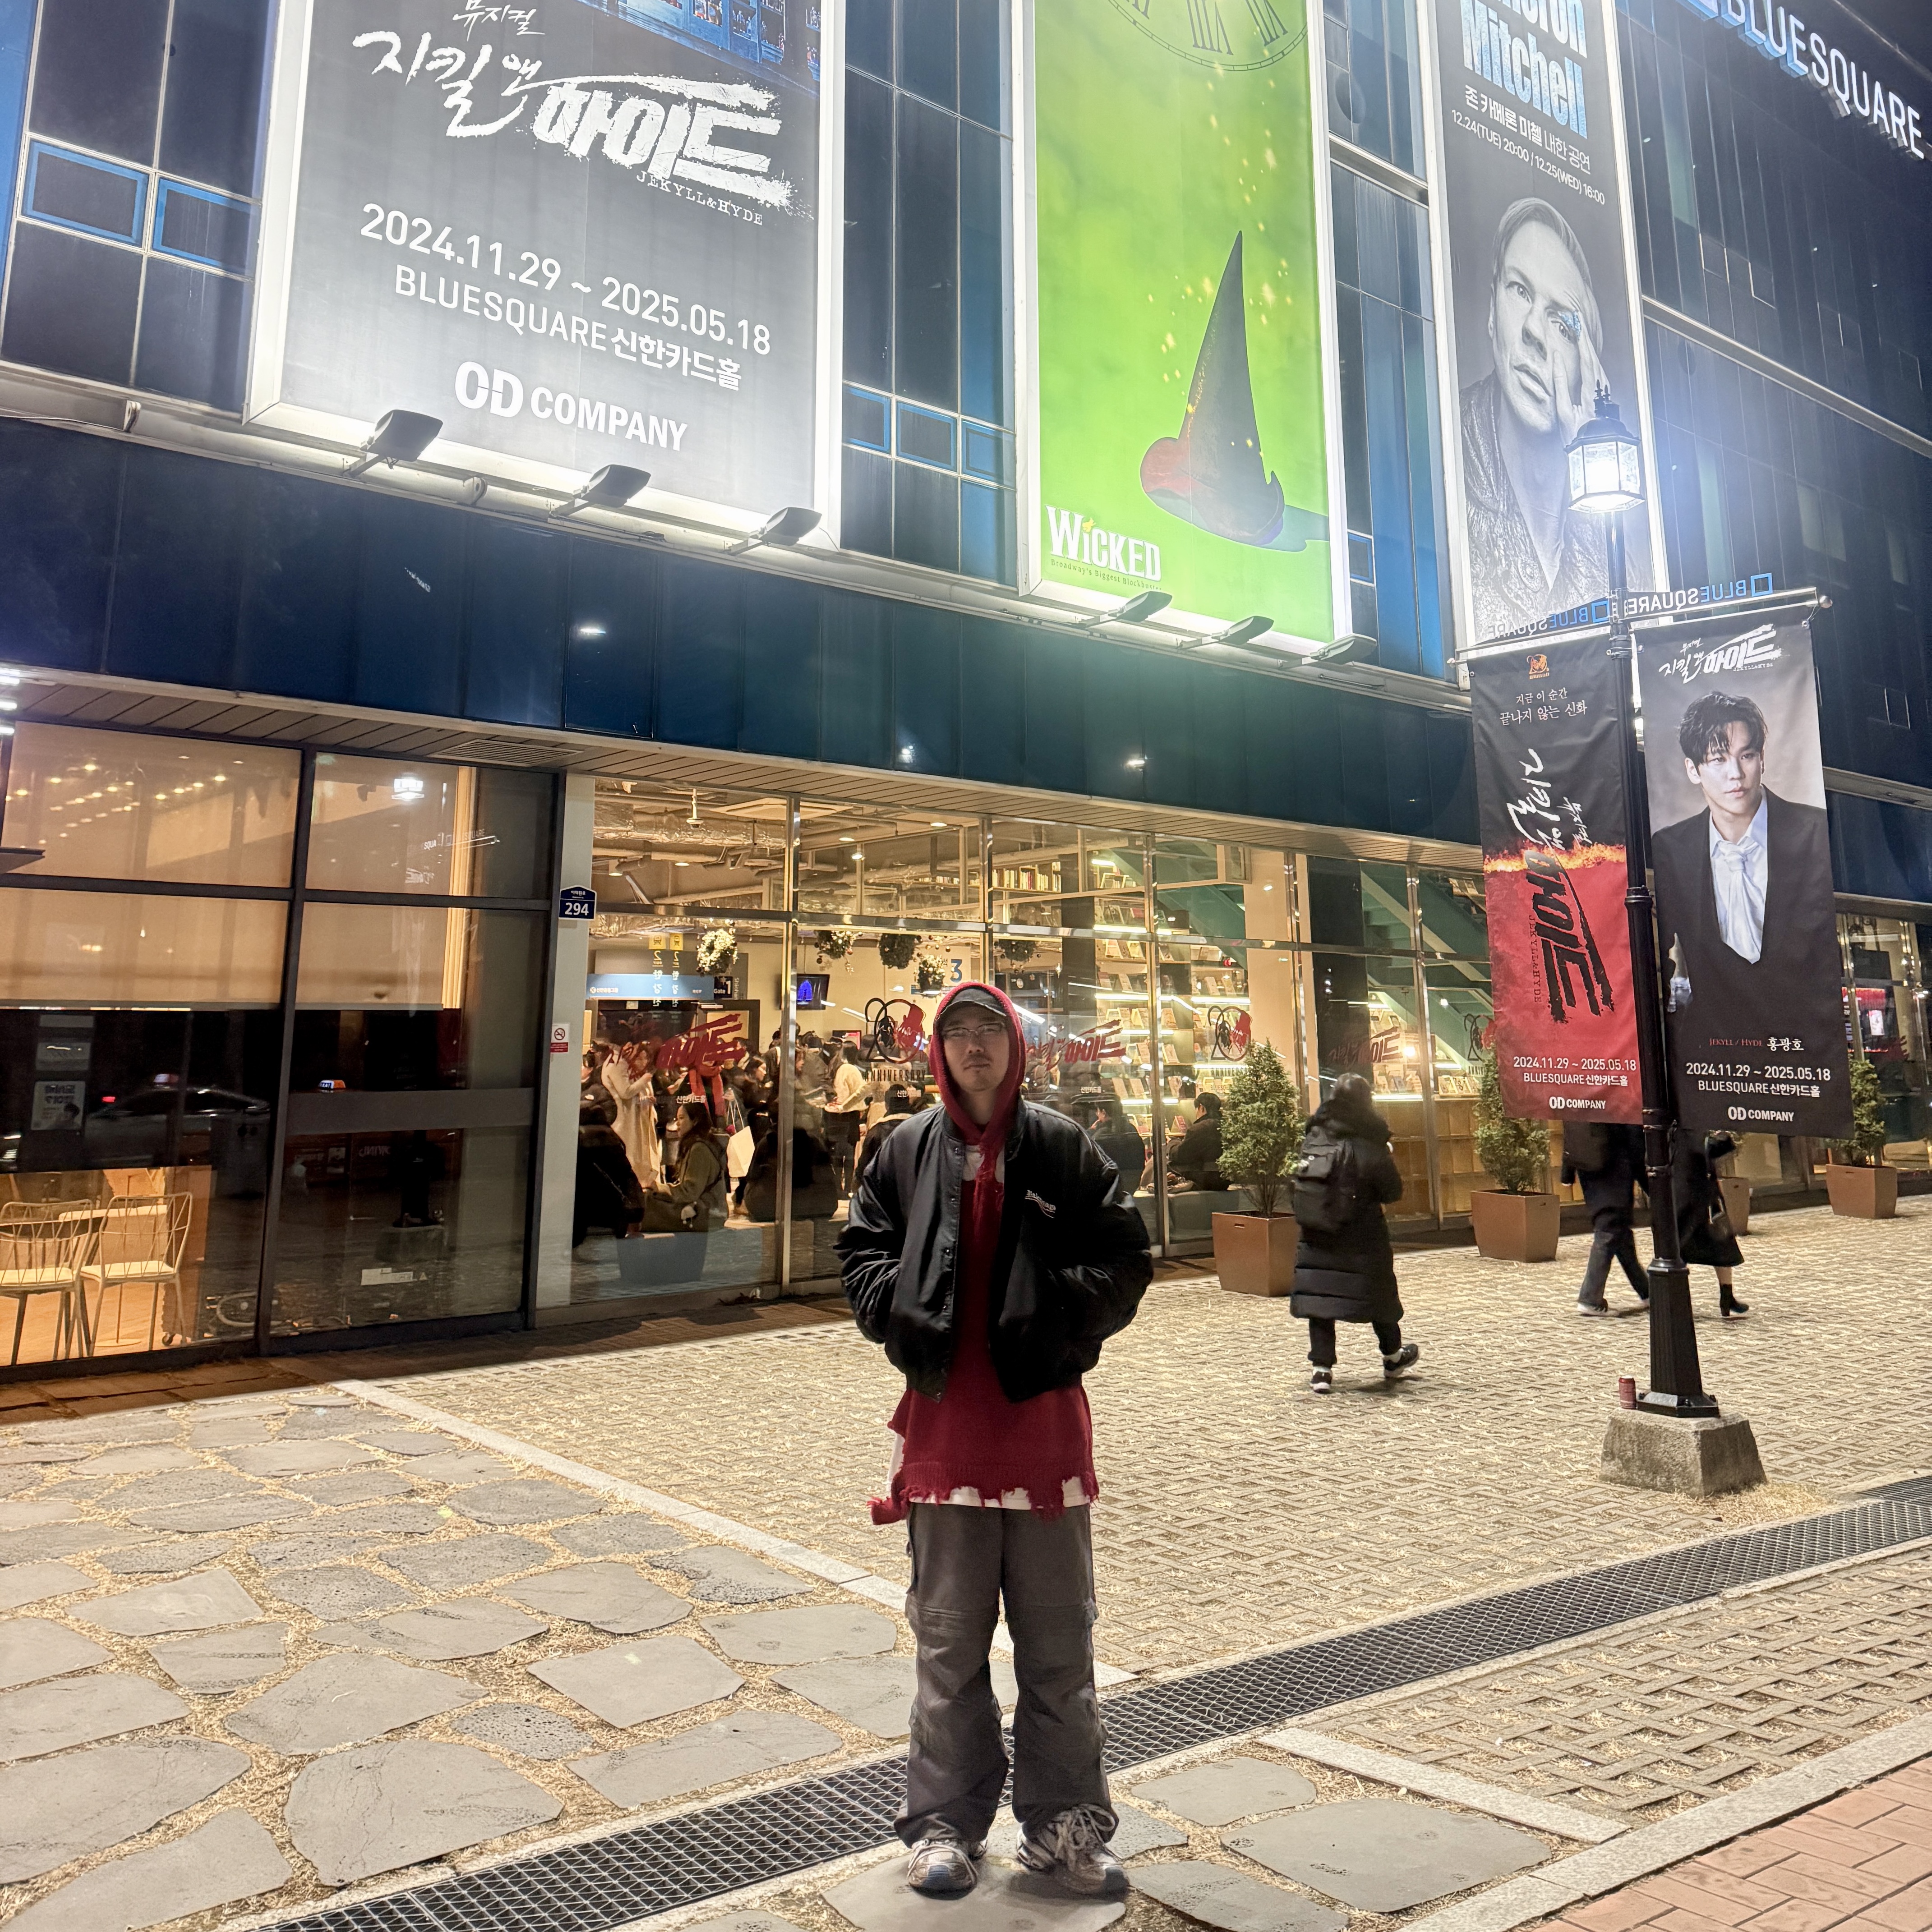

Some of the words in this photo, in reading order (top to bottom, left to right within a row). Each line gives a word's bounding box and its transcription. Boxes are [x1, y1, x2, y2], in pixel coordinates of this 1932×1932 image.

[452, 0, 545, 41] 뮤지컬
[1460, 0, 1587, 139] Mitchell
[1722, 0, 1924, 159] BLUESQUARE
[1465, 84, 1478, 110] 존
[1480, 93, 1517, 132] 카메론
[1519, 116, 1543, 147] 미첼
[1451, 109, 1502, 150] 12.24(TUE)
[1503, 138, 1530, 162] 20:00
[1535, 155, 1582, 195] 12.25(WED)
[1582, 183, 1605, 205] 16:00
[636, 170, 763, 225] JEKYLL&HYDE
[360, 203, 562, 291] 2024.11.29
[601, 276, 771, 355] 2025.05.18
[454, 361, 524, 418] OD
[530, 386, 688, 451] COMPANY
[1051, 559, 1092, 575] Broadway's
[1095, 570, 1120, 582] Biggest
[1516, 693, 1533, 705] 지금
[1536, 690, 1545, 702] 이
[1548, 687, 1568, 701] 순간
[1499, 708, 1532, 726] 끝나지
[1537, 706, 1560, 721] 않는
[1565, 700, 1588, 717] 신화
[565, 902, 589, 916] 294
[950, 959, 963, 983] 3
[1767, 1037, 1804, 1051] 홍광호
[1513, 1056, 1569, 1069] 2024.11.29
[1581, 1058, 1637, 1071] 2025.05.18
[1686, 1063, 1750, 1077] 2024.11.29
[1764, 1066, 1831, 1081] 2025.05.18
[1549, 1096, 1565, 1109] OD
[1566, 1098, 1606, 1110] COMPANY
[1728, 1106, 1747, 1121] OD
[1748, 1109, 1794, 1122] COMPANY
